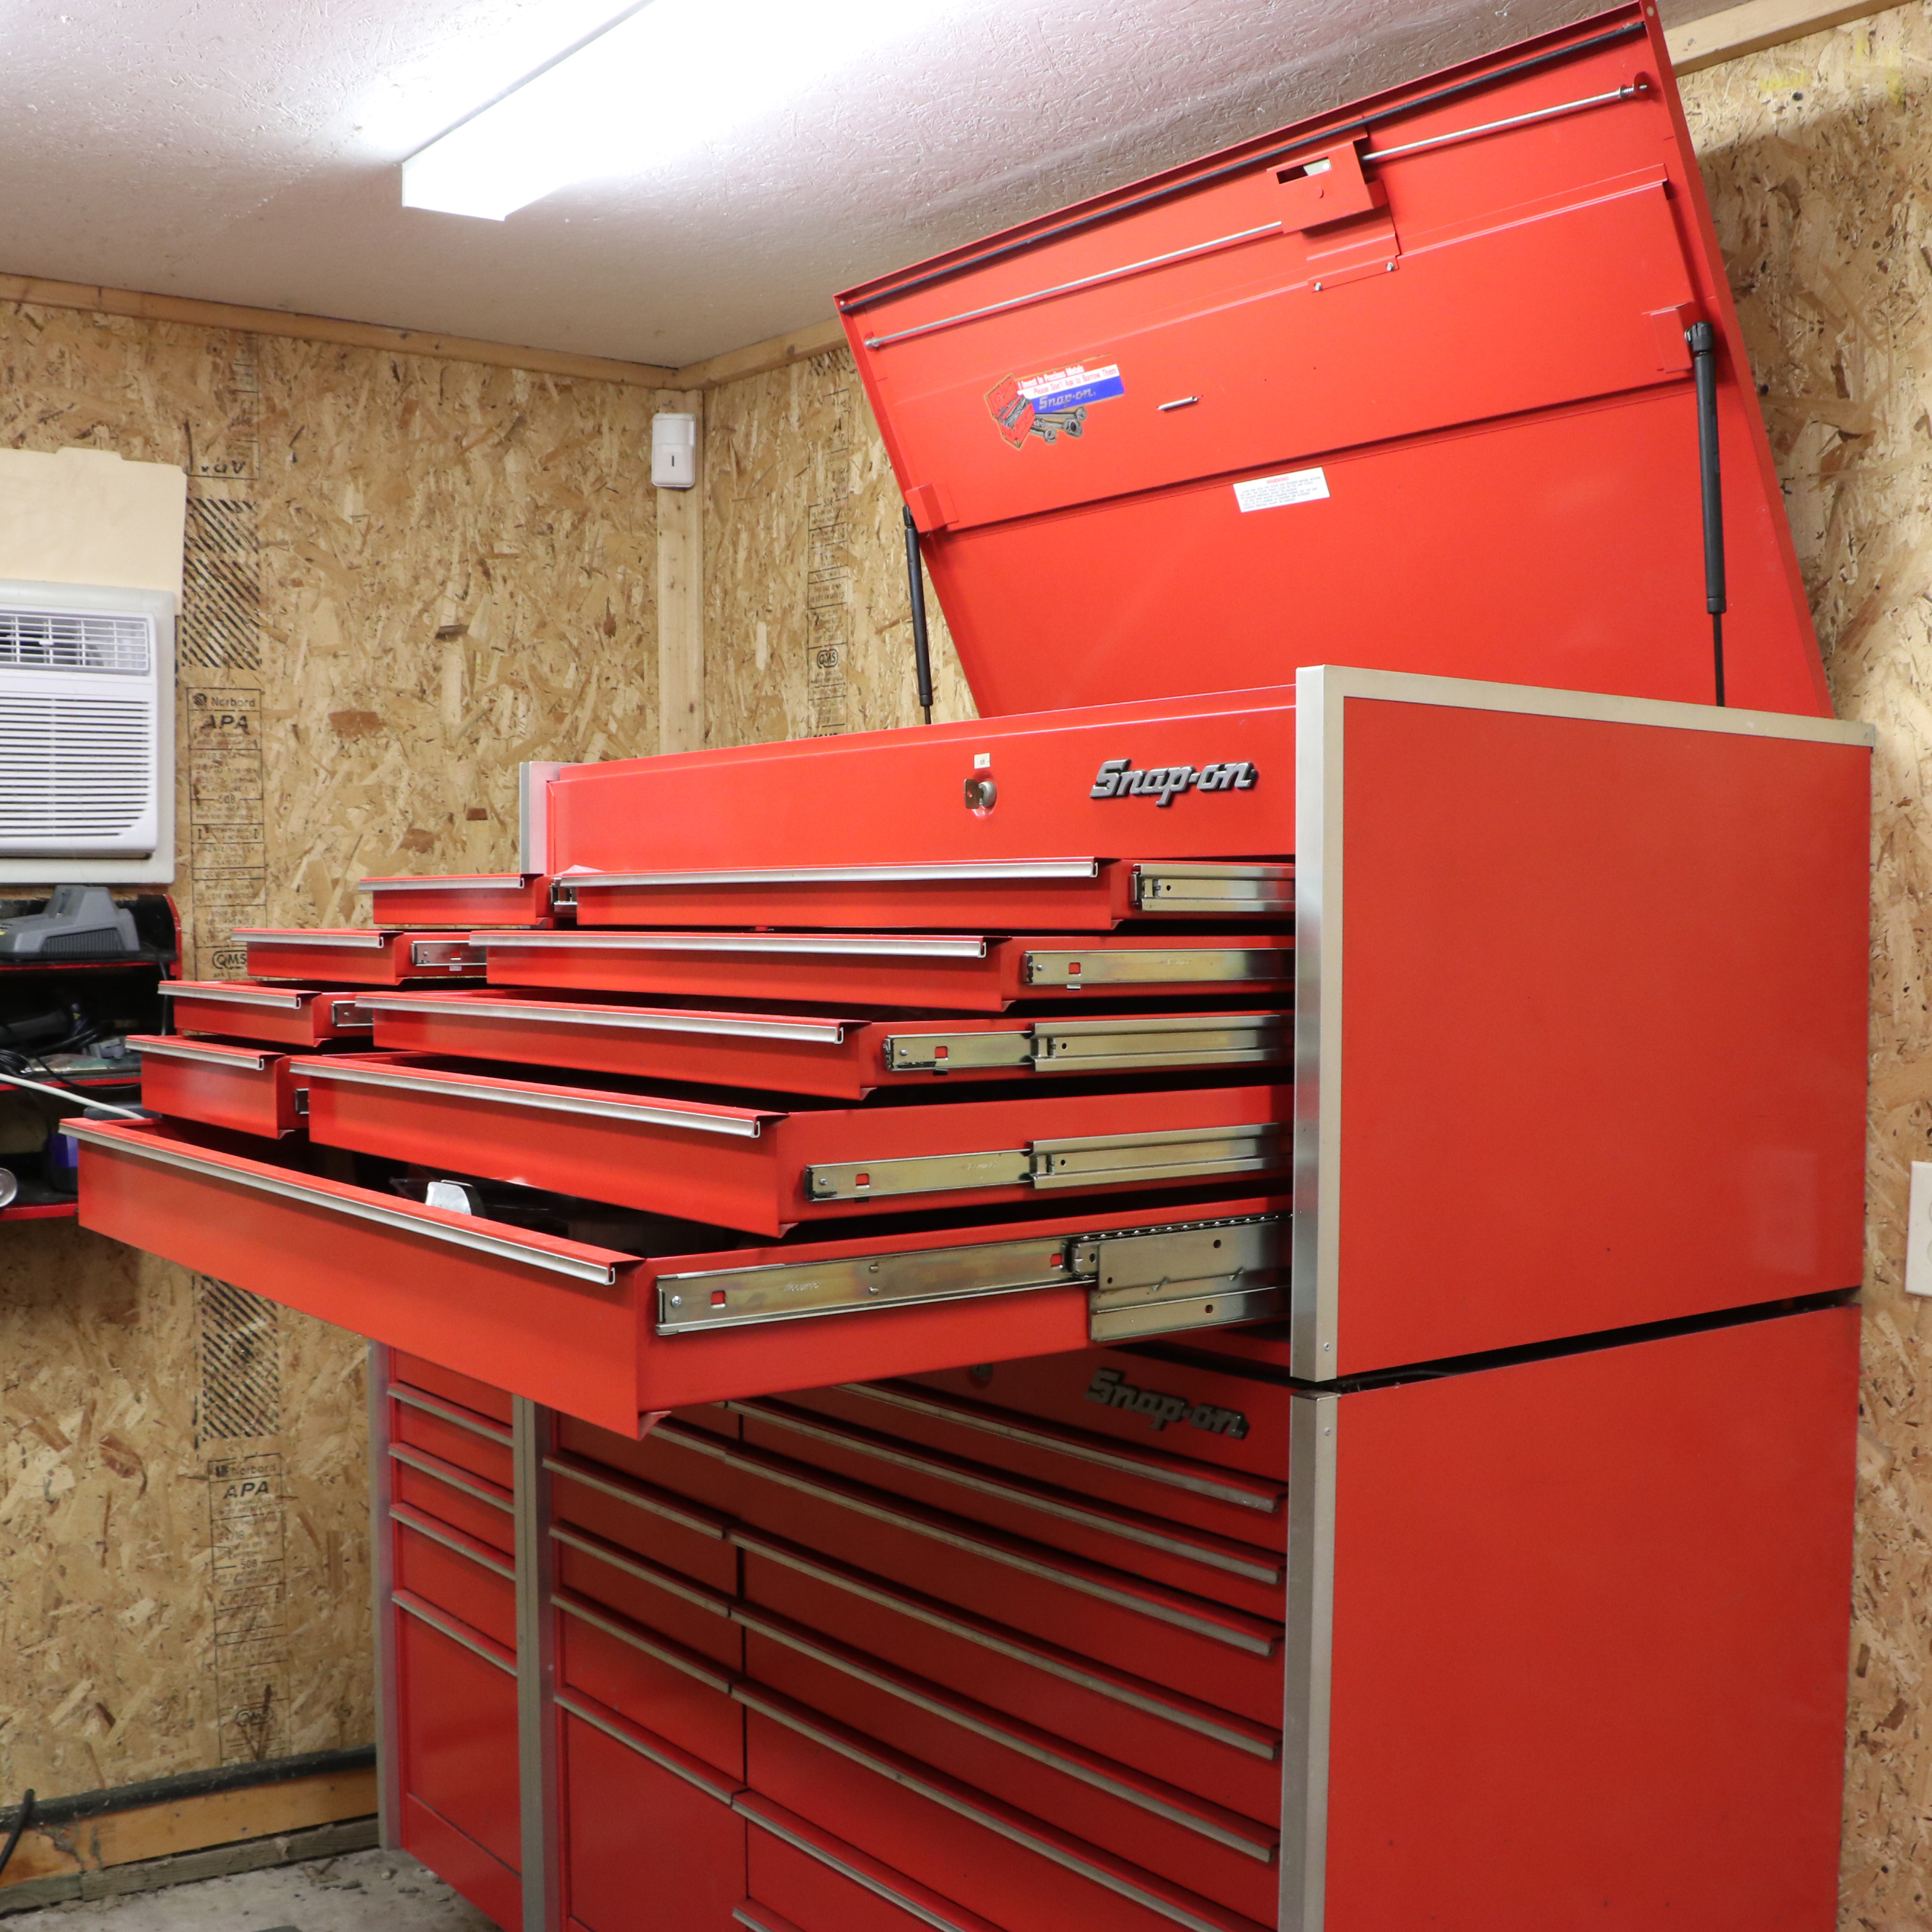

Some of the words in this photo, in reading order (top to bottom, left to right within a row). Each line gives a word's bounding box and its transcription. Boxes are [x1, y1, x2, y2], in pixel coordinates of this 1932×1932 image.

[1021, 378, 1038, 388] Invest
[1044, 371, 1066, 383] Precious
[1066, 364, 1085, 377] Metals
[1033, 386, 1050, 396] Please
[1050, 382, 1064, 391] Don't
[1065, 378, 1074, 387] Ask
[1082, 373, 1101, 383] Borrow
[1101, 367, 1118, 377] Them
[1039, 388, 1096, 410] Snap-on
[1266, 476, 1289, 484] WARNING
[819, 652, 836, 665] QMS
[212, 697, 255, 707] Norbord
[200, 715, 248, 729] APA
[1090, 758, 1258, 806] Snap-on
[218, 795, 236, 805] 508
[217, 954, 246, 965] QMS
[1084, 1367, 1250, 1439] Snap-on
[223, 1481, 268, 1498] APA
[240, 1559, 258, 1570] 508
